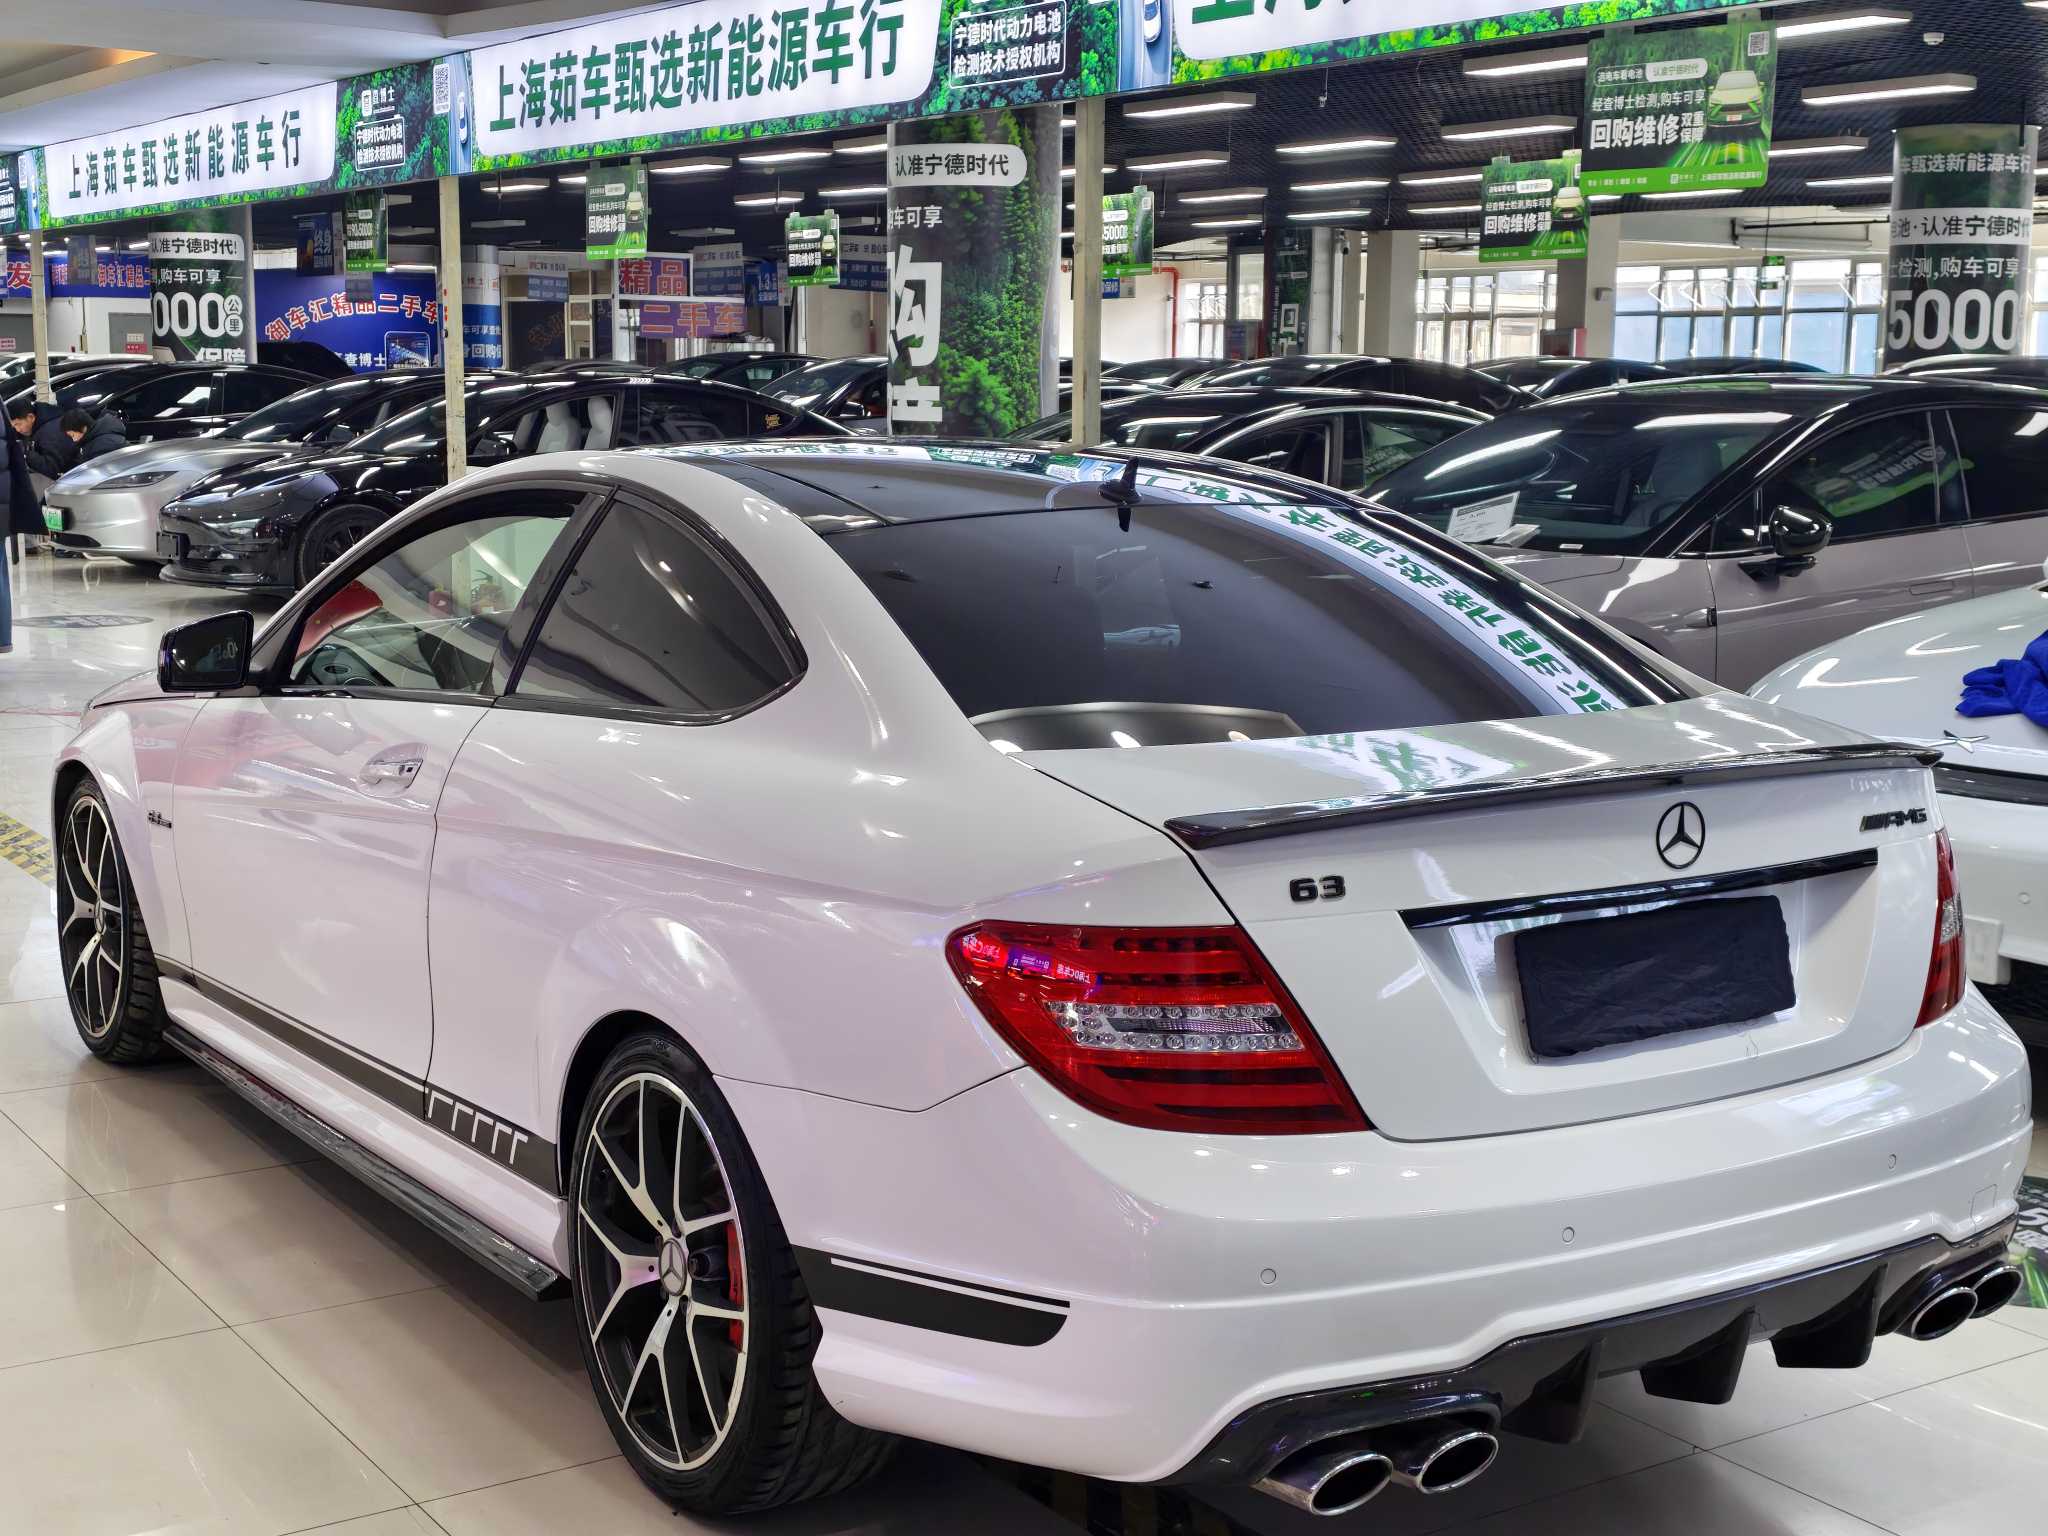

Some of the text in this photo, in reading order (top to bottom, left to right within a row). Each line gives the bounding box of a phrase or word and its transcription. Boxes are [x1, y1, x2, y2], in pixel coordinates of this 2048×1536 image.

[954, 8, 1062, 49] 宁德时代动力电池
[489, 0, 904, 132] 上海茹车甄选新能源车行
[953, 40, 1062, 78] 检测技术授权机构
[1592, 89, 1706, 112] 经查博士检测,购车可享
[1590, 114, 1680, 150] 回购维修
[69, 110, 301, 199] 上海茹车甄选新能源车行
[895, 153, 1009, 177] 认准宁德时代
[1484, 212, 1537, 236] 回购维修
[619, 257, 688, 296] 精品
[641, 303, 745, 338] 二手车
[1887, 288, 2019, 350] 5000
[336, 351, 386, 367] 查博士
[1880, 807, 1928, 829] AMG
[1290, 875, 1347, 903] 63
